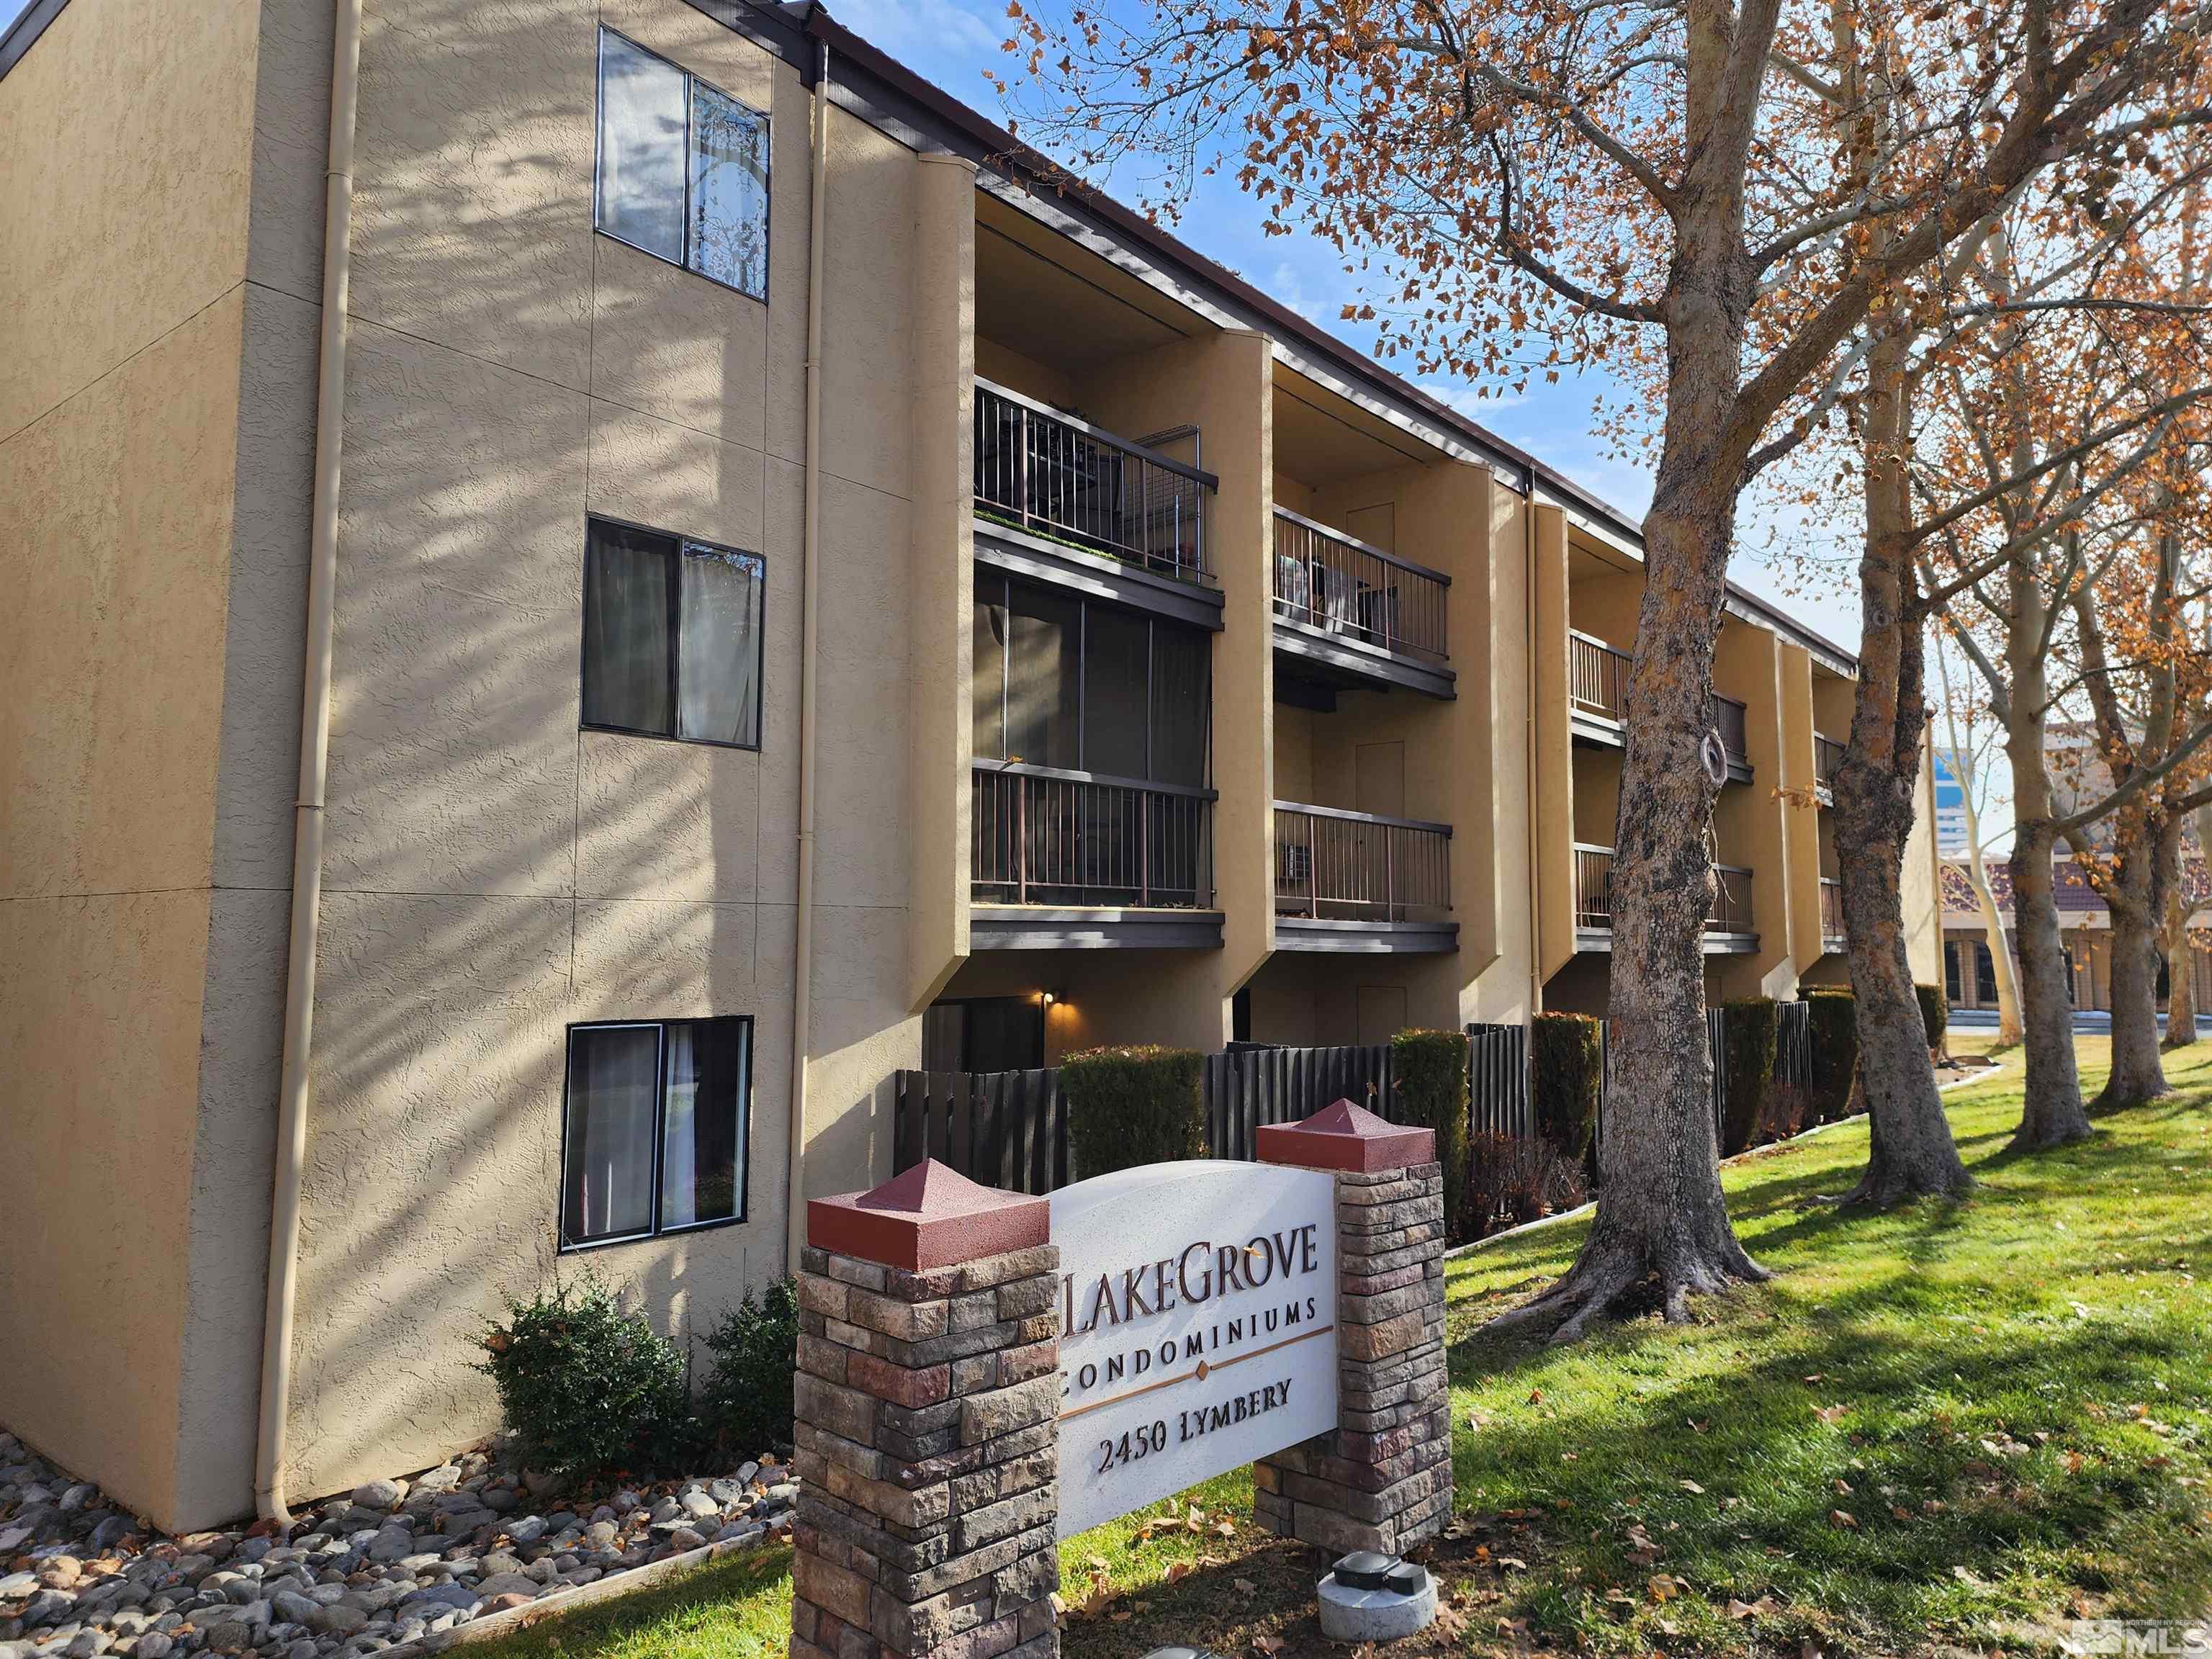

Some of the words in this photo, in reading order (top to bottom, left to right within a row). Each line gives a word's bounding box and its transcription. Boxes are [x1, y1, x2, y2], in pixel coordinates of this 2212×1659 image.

[1061, 1223, 1318, 1339] LAKEGROVE
[1098, 1420, 1167, 1474] 2450
[1180, 1377, 1292, 1442] LYMBERY
